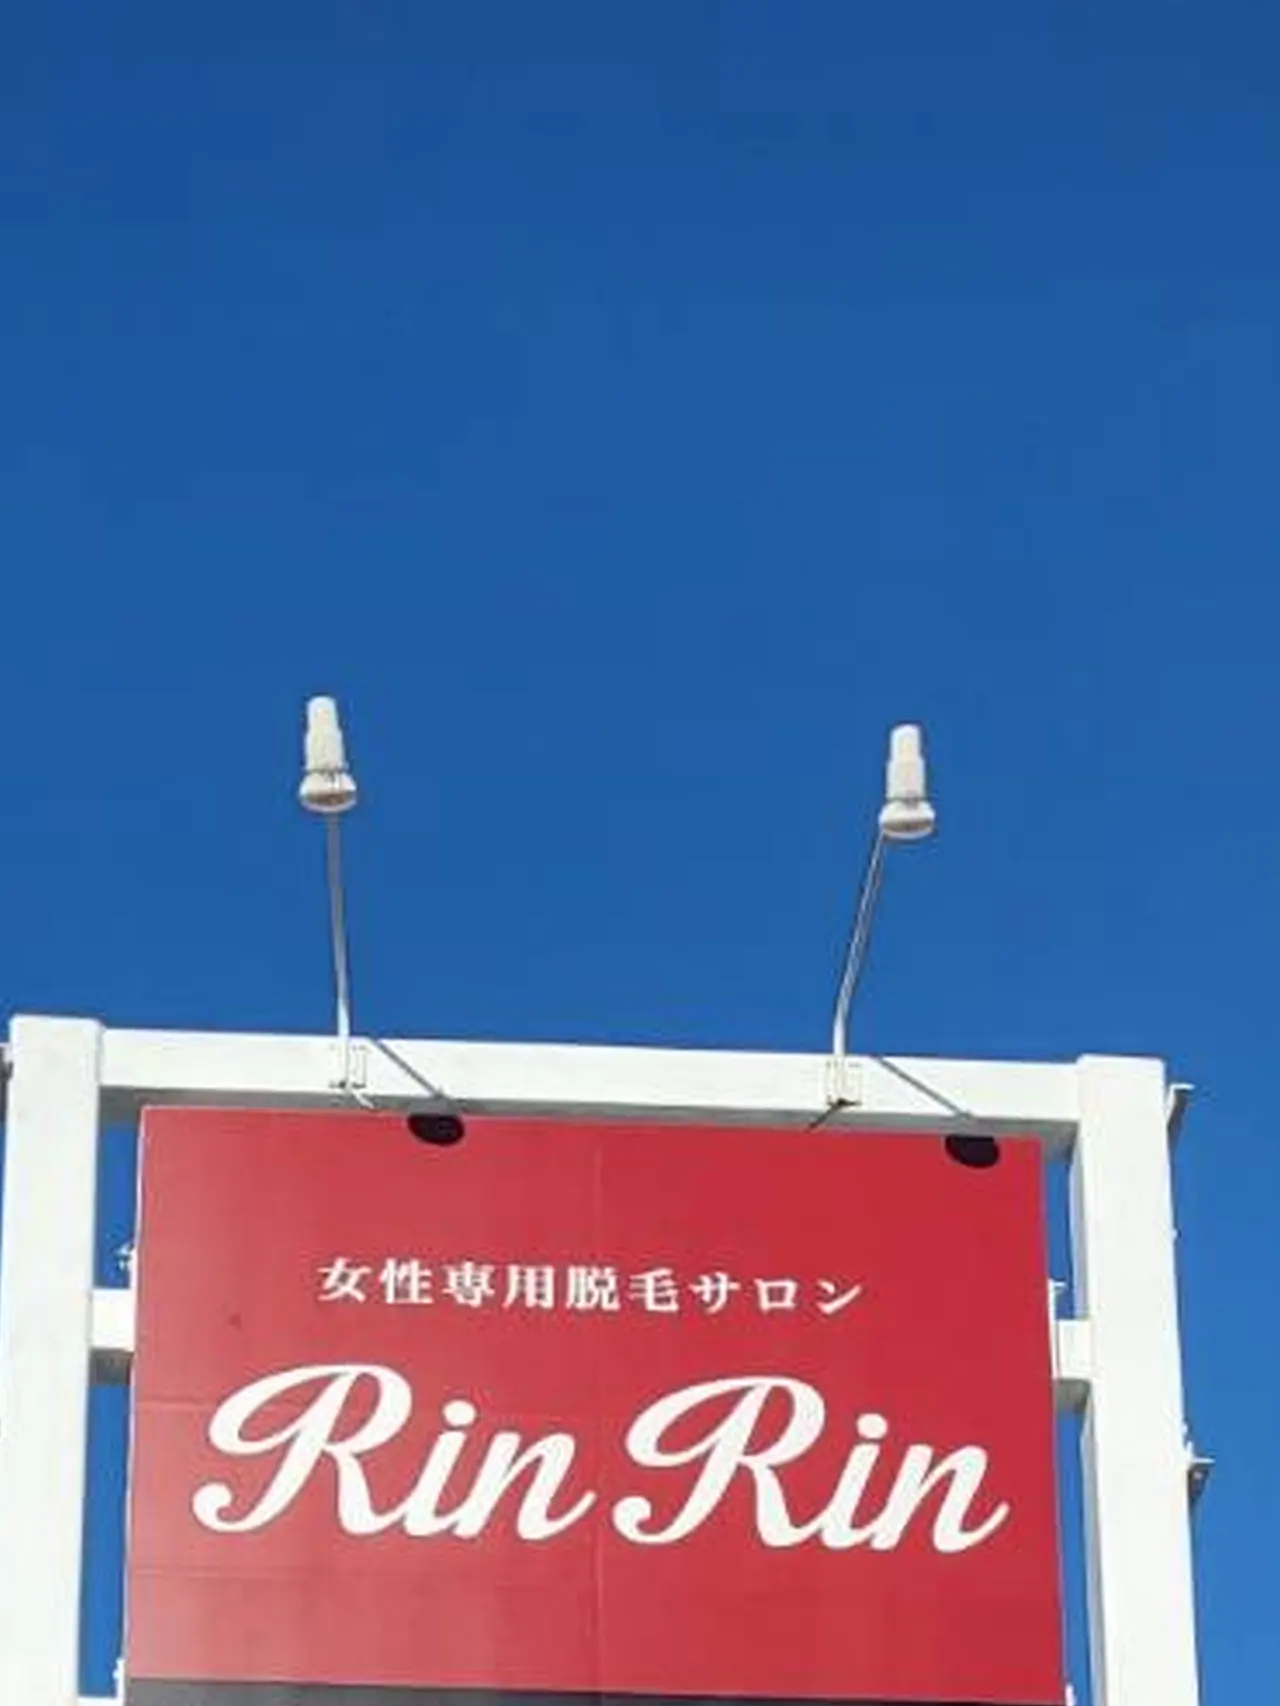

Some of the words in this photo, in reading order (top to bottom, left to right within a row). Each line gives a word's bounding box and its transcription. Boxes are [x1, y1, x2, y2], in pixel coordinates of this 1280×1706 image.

[317, 1256, 862, 1316] 女性専用脱毛サロン
[192, 1363, 596, 1541] Rin
[613, 1376, 1009, 1553] Rin
